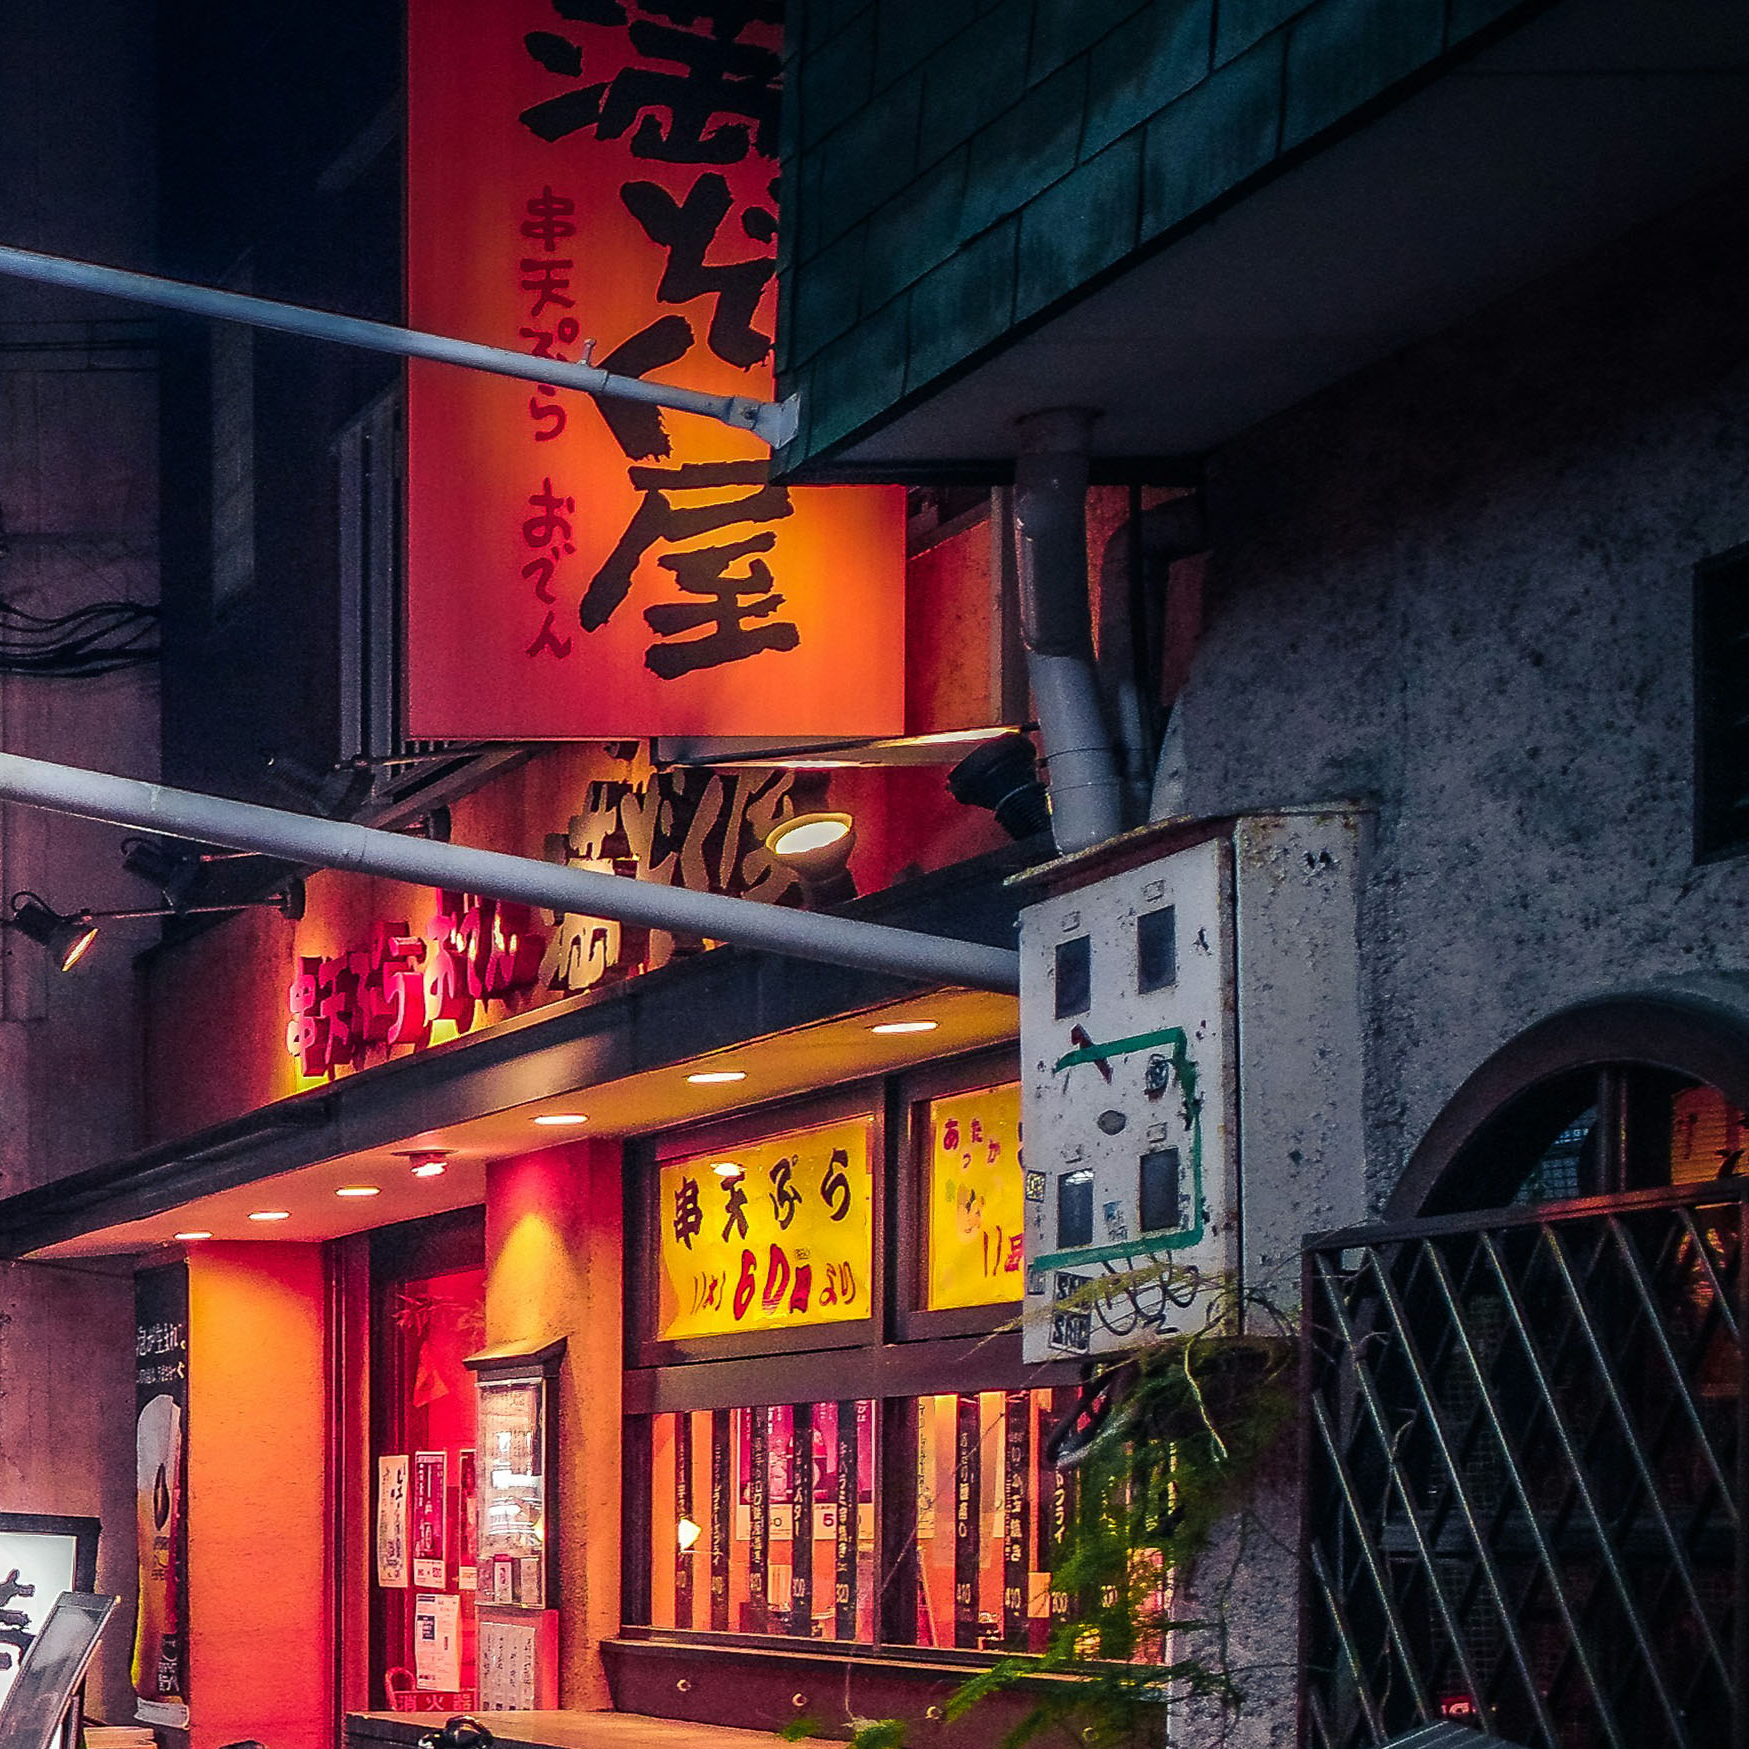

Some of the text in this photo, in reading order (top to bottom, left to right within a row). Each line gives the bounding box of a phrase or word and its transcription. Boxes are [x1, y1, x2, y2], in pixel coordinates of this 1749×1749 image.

[522, 477, 576, 659] おでん
[673, 1149, 851, 1250] 串天ぷら
